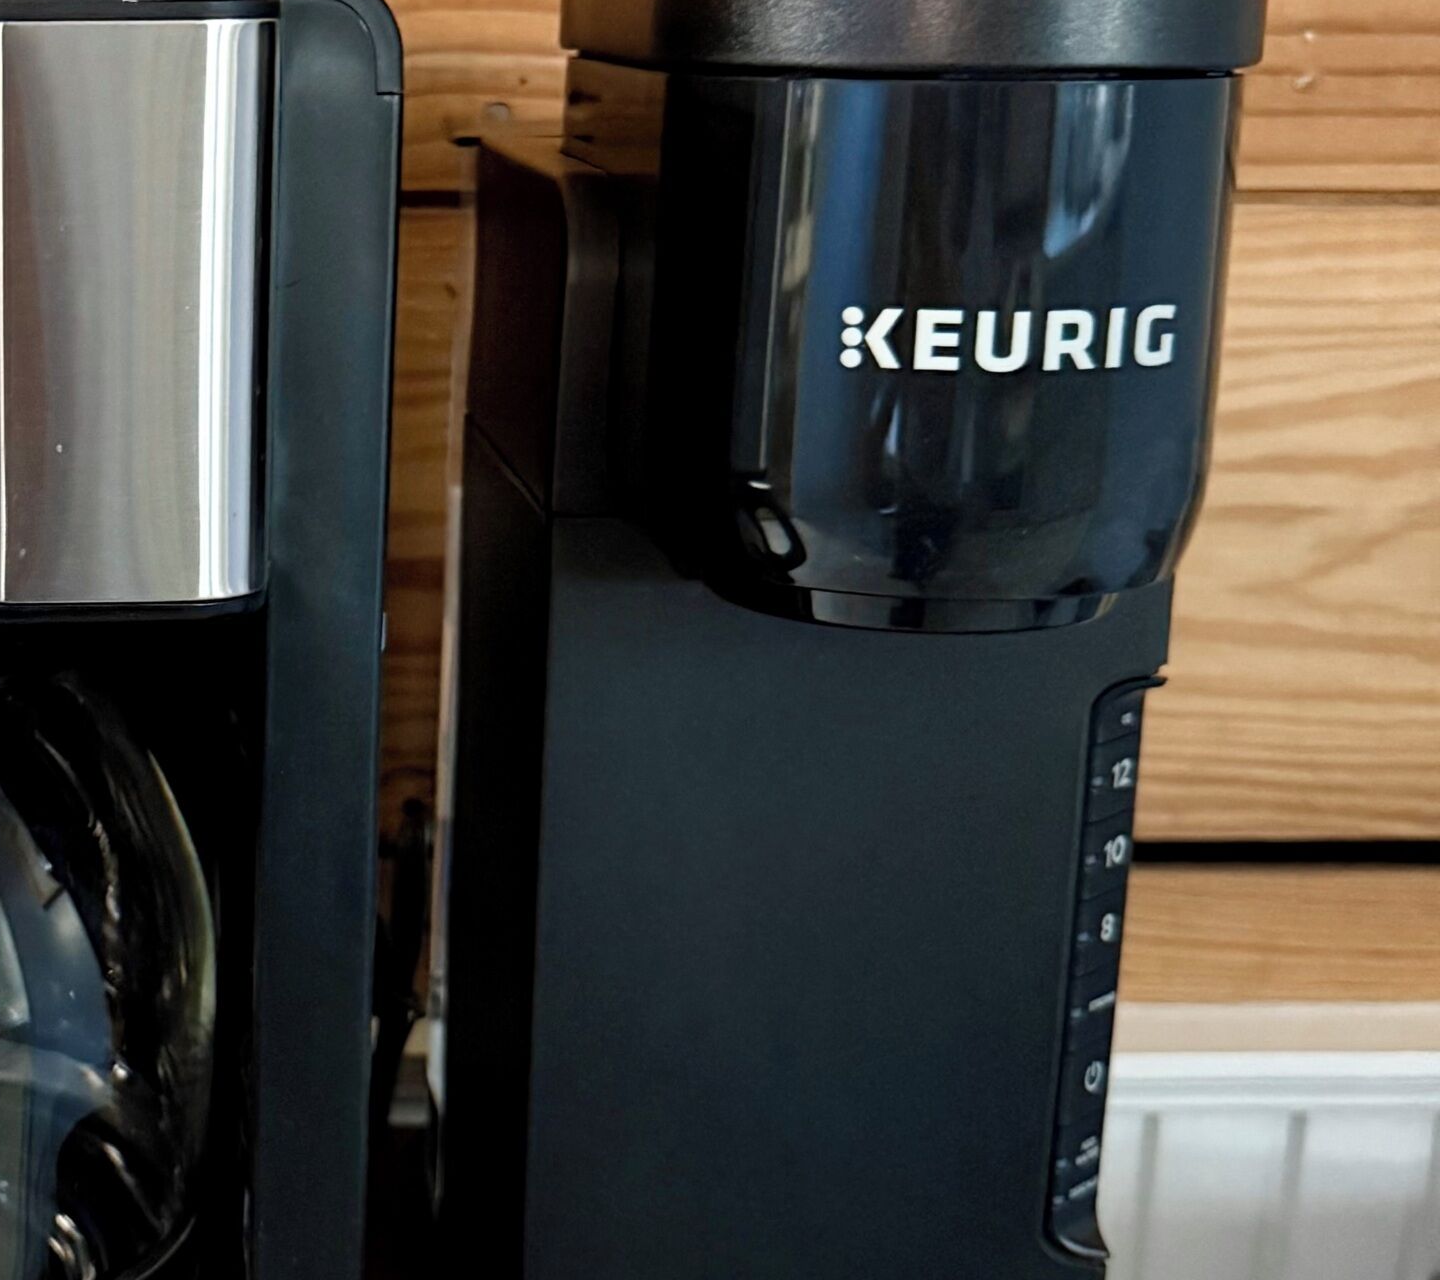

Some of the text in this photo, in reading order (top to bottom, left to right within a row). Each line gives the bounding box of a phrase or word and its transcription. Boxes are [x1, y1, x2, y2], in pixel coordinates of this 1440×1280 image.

[840, 304, 1177, 373] KEURIG
[1112, 757, 1133, 789] 12
[1104, 834, 1131, 868] 10
[1100, 913, 1117, 943] 8
